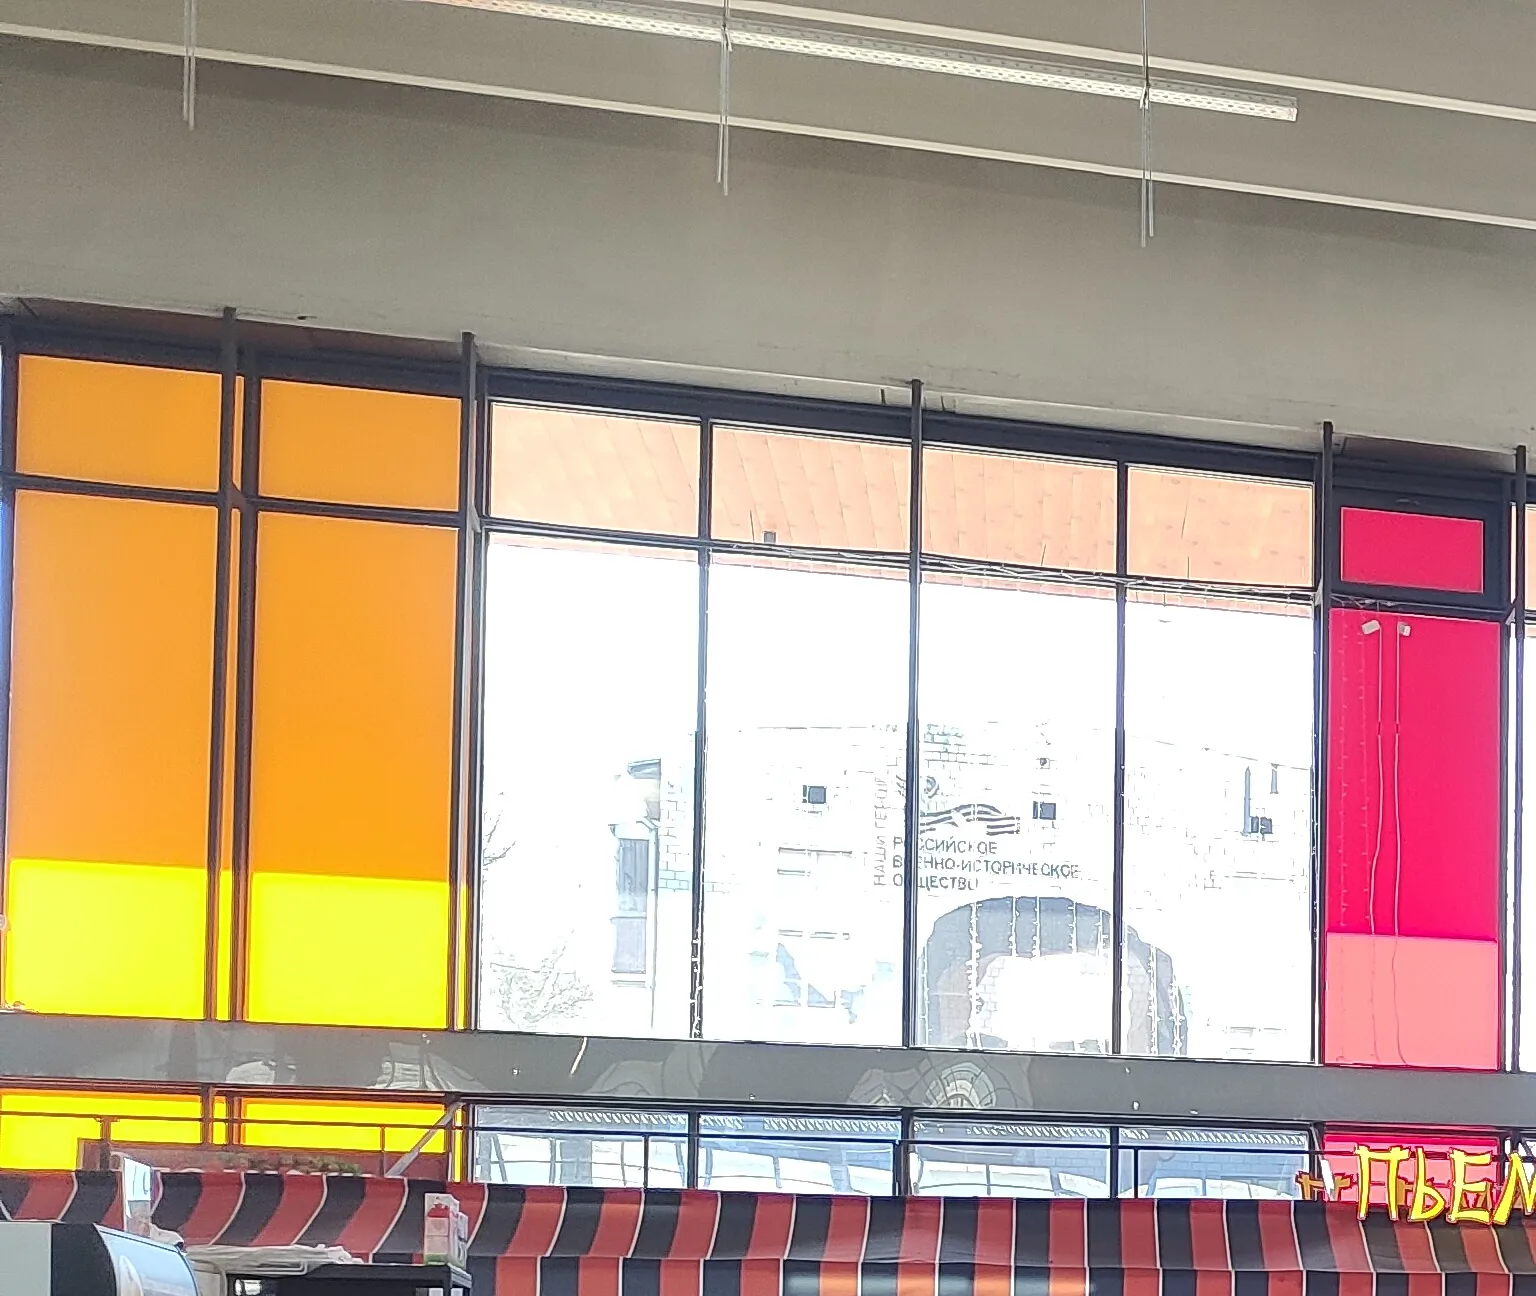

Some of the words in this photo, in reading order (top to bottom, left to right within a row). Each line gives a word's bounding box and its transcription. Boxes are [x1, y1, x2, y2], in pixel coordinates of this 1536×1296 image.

[893, 836, 998, 855] РСИЙСКОЕ
[892, 856, 1080, 879] ВННО-ИСТОРИЧЕСКОЕ
[892, 873, 979, 891] ОЩЕСТВО
